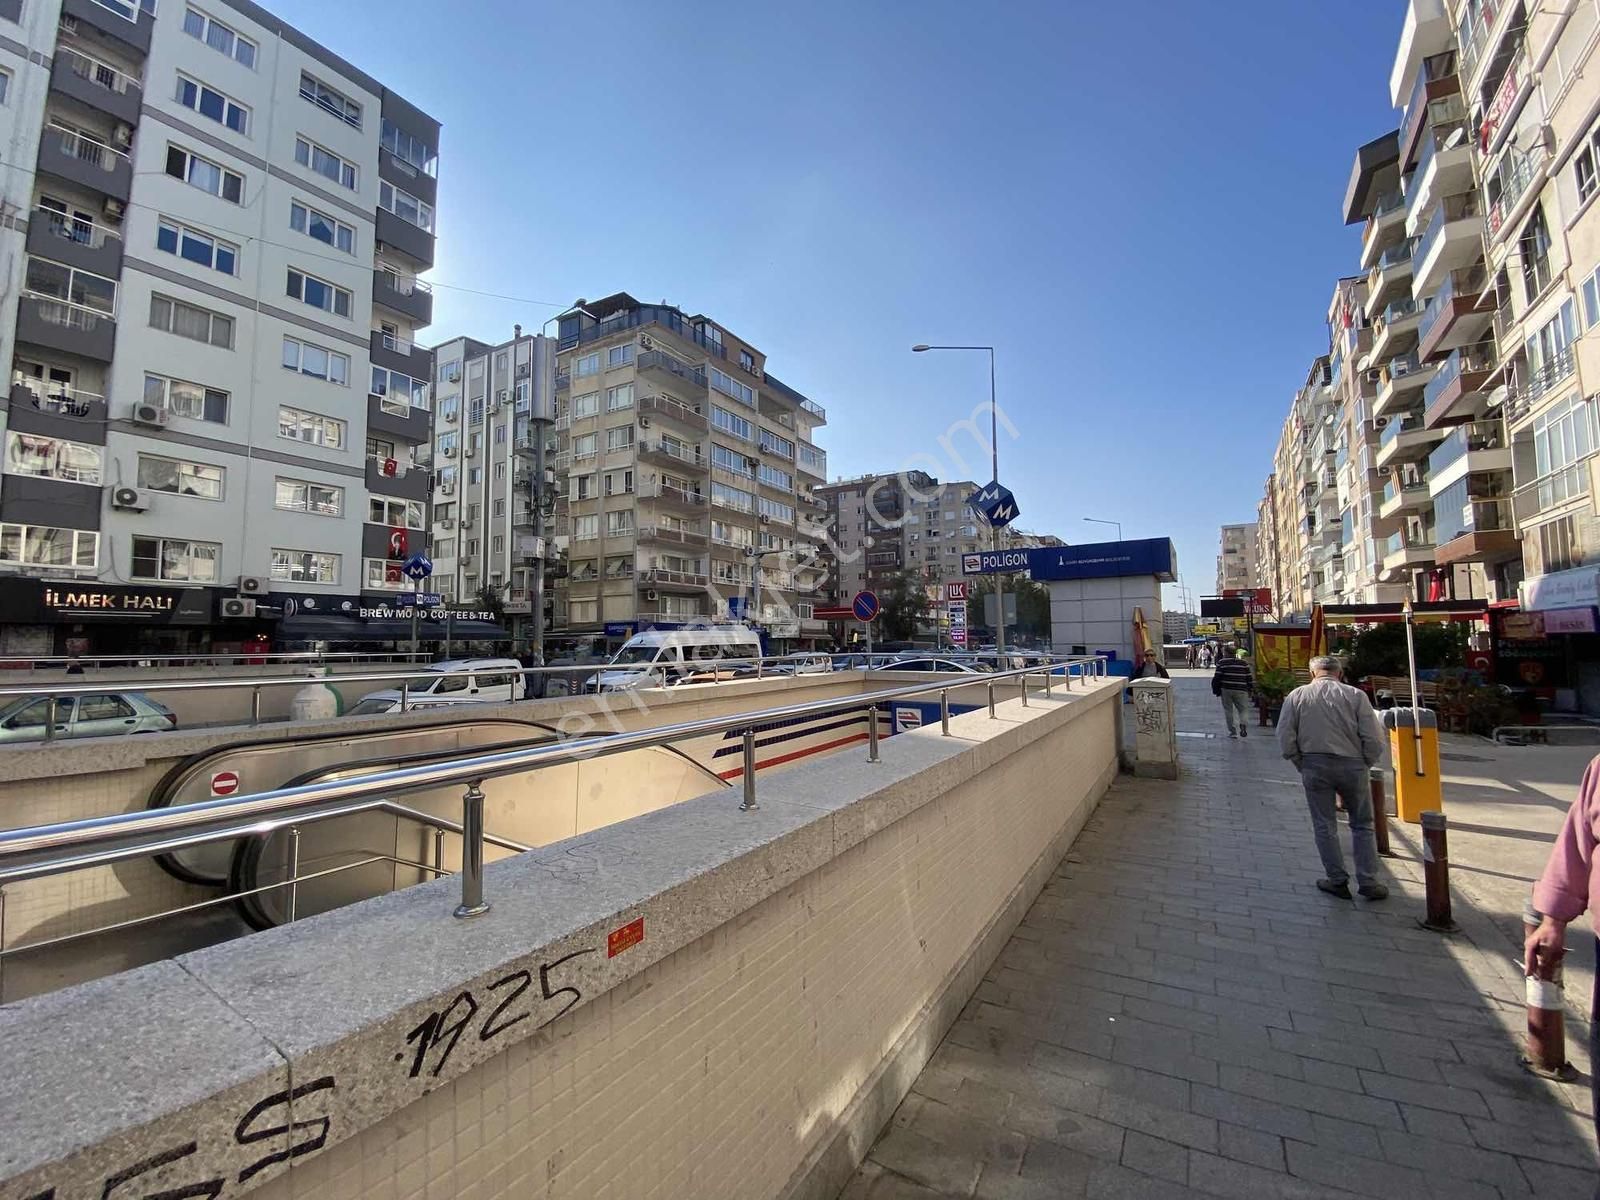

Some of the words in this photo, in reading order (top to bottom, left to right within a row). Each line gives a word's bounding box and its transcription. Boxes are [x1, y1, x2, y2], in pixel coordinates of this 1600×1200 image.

[993, 504, 1013, 520] M
[983, 552, 1028, 568] POLİGON
[409, 567, 424, 575] M
[46, 589, 115, 608] İLMEK
[360, 608, 394, 618] BREW
[478, 611, 495, 620] TEA
